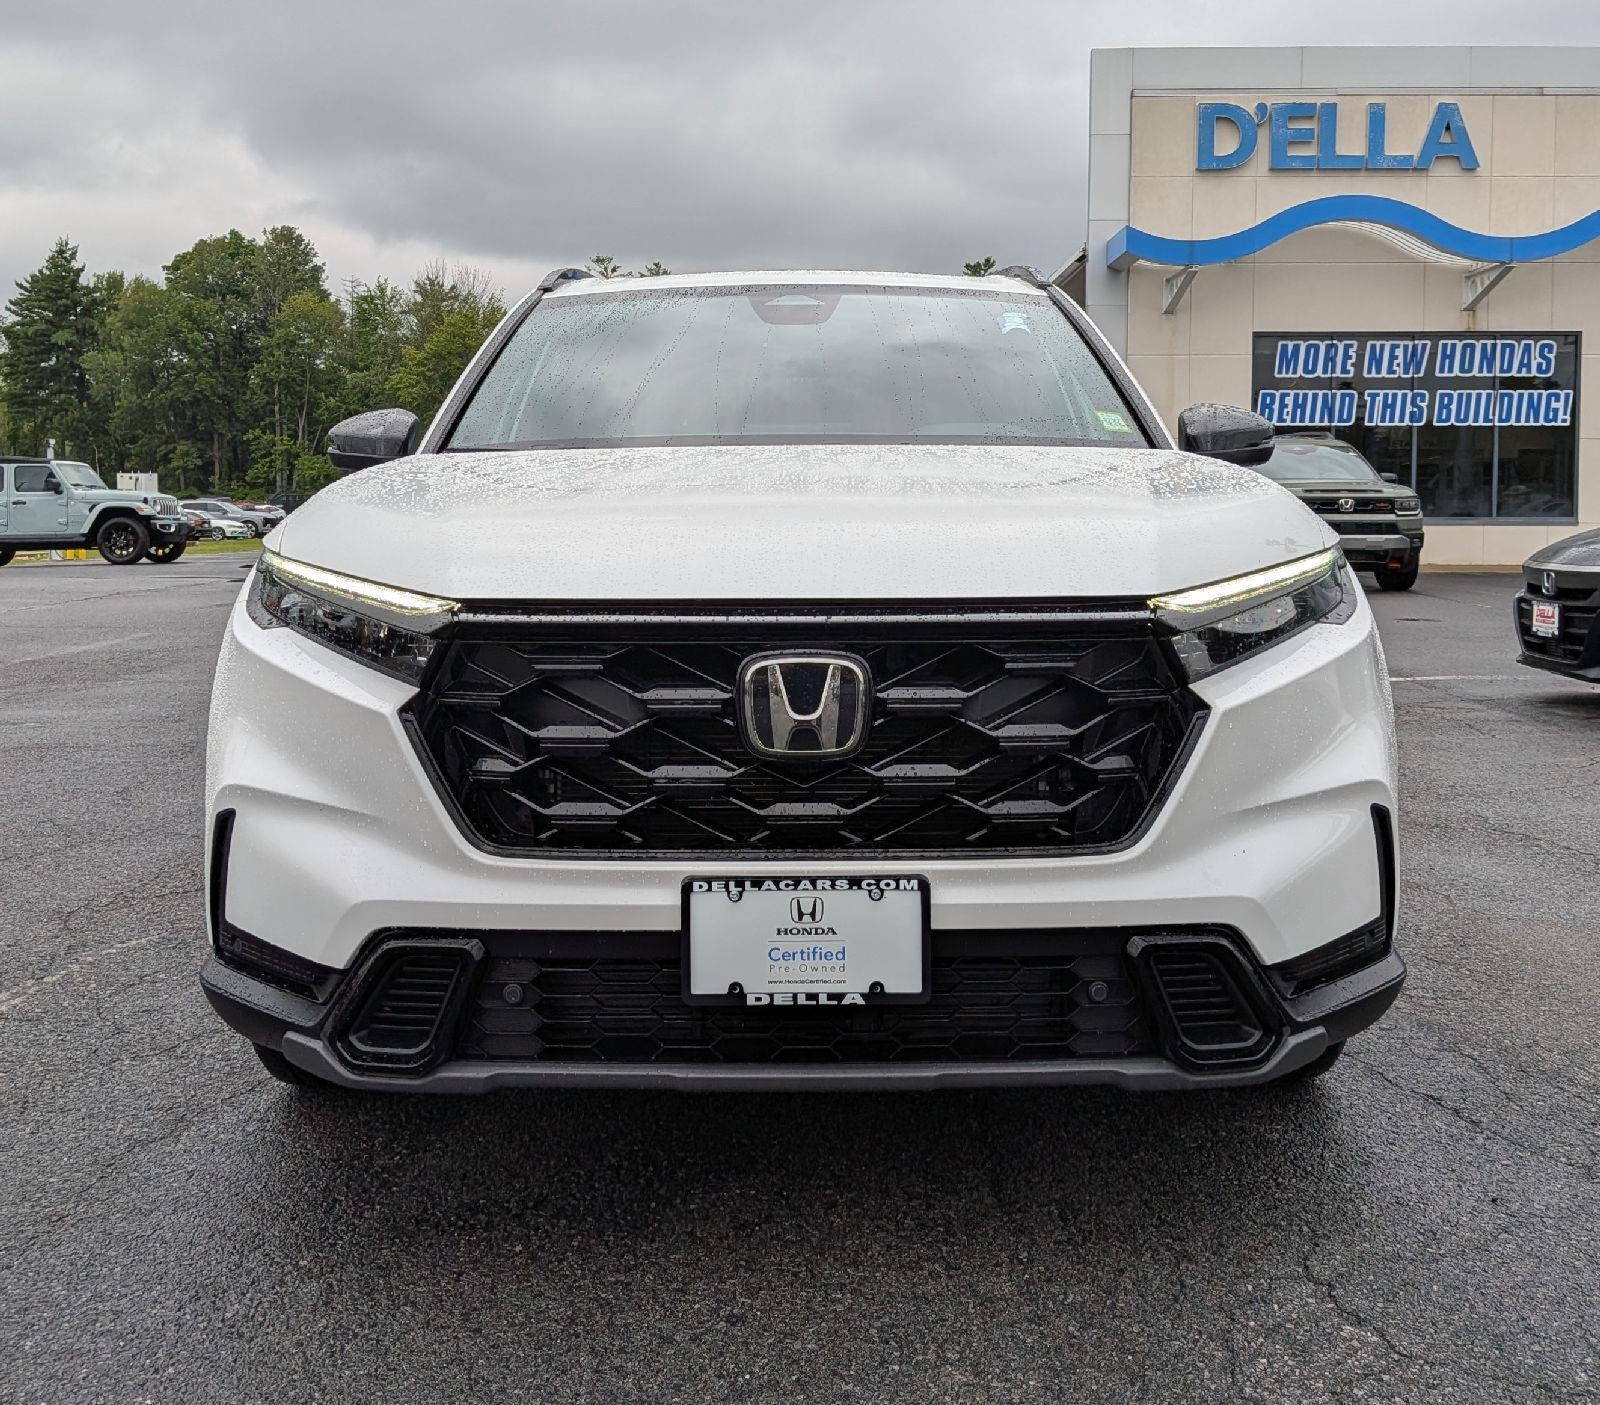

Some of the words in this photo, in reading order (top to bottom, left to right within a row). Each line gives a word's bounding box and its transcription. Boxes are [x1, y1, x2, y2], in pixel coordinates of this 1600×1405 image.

[1275, 340, 1357, 378] MORE
[1363, 340, 1431, 378] NEW
[1435, 340, 1557, 377] HONDAS
[1257, 390, 1358, 426] BEHIND
[1364, 390, 1429, 426] THIS
[1433, 390, 1573, 426] BUILDING!
[692, 879, 919, 892] DELLACARS.COM
[776, 927, 838, 936] HONDA
[768, 946, 846, 962] Certified
[769, 963, 846, 973] Pre-Owned
[746, 993, 866, 1006] DELLA
